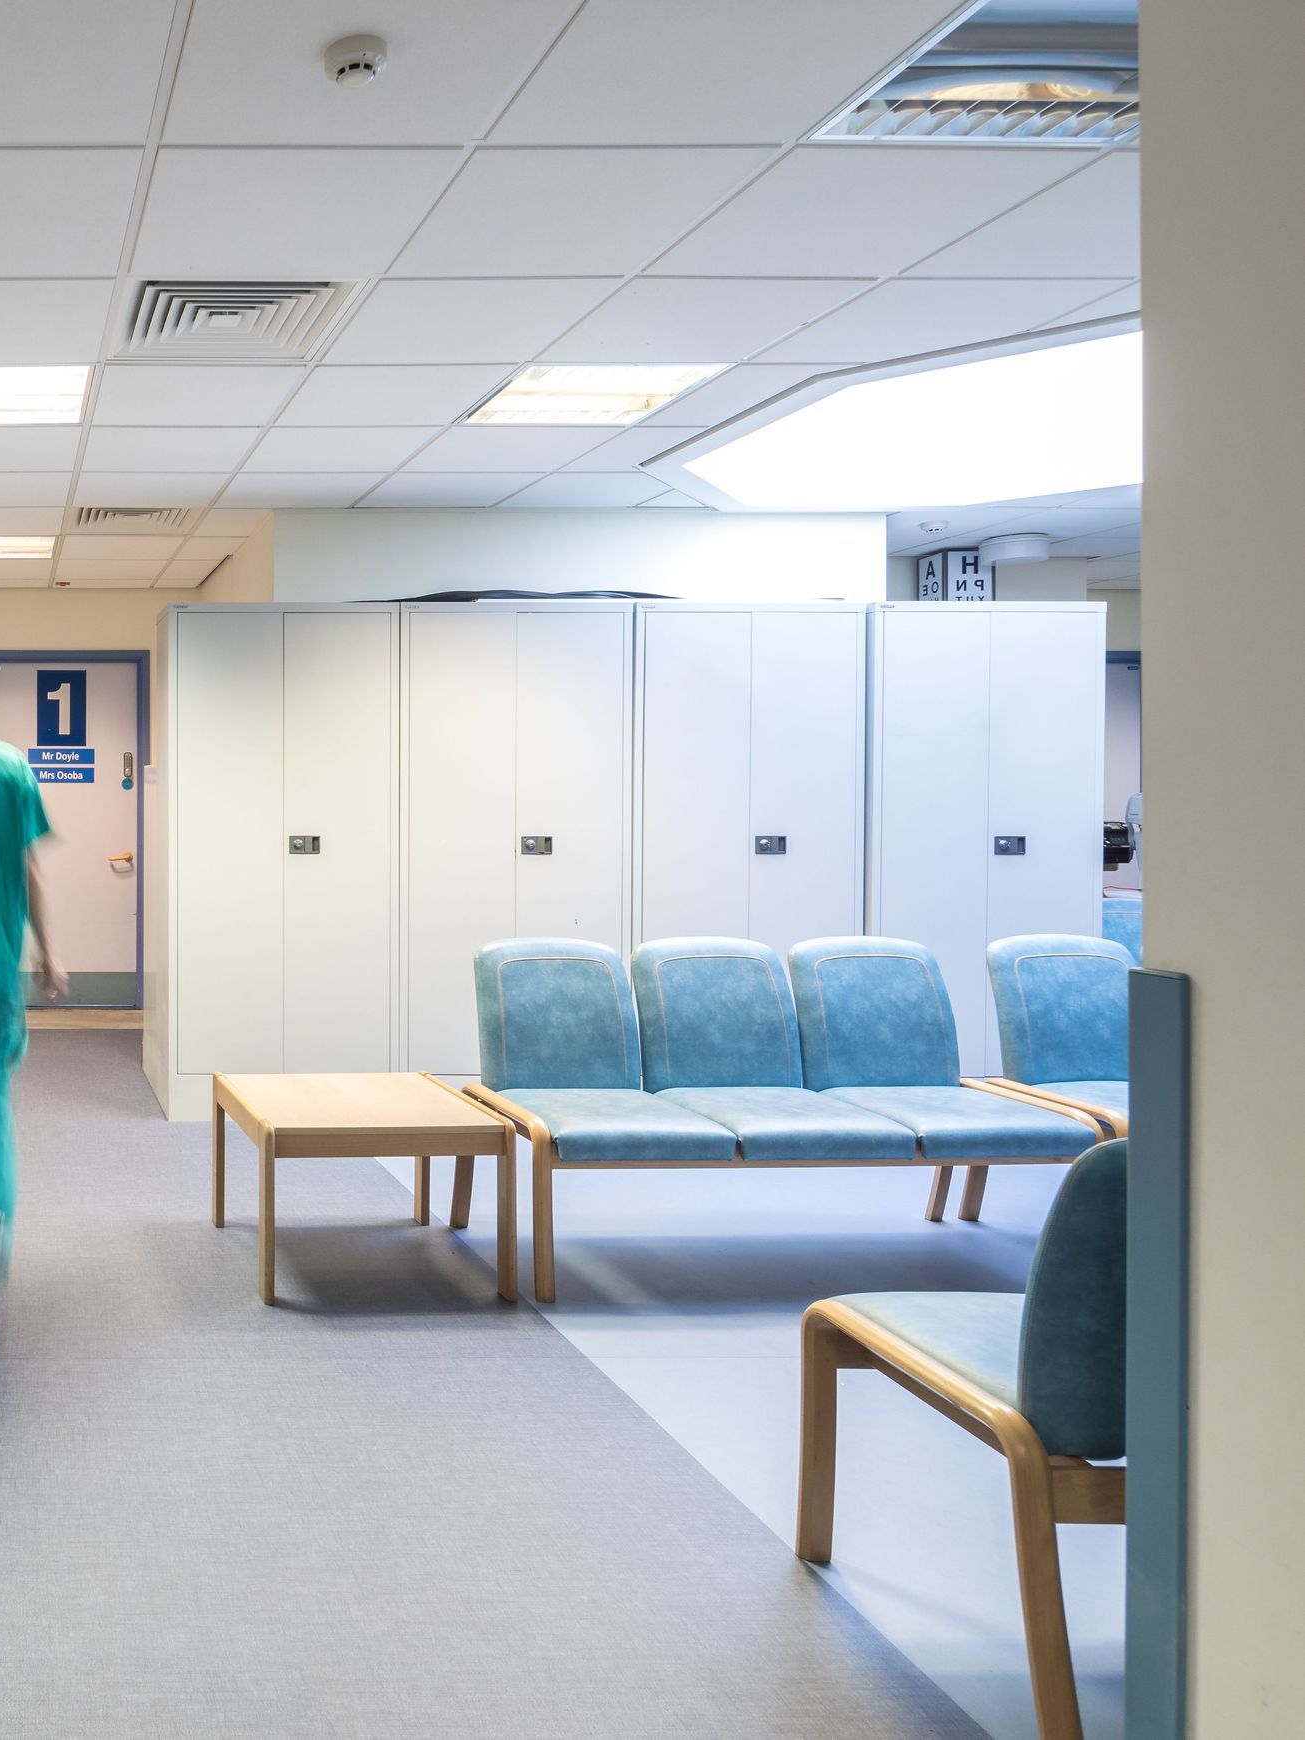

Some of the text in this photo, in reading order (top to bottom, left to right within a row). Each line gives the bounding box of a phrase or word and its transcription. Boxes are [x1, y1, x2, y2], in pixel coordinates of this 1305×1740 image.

[47, 683, 71, 736] 1
[42, 752, 80, 763] Mr Doyle
[39, 771, 83, 780] Mrs Osoba
